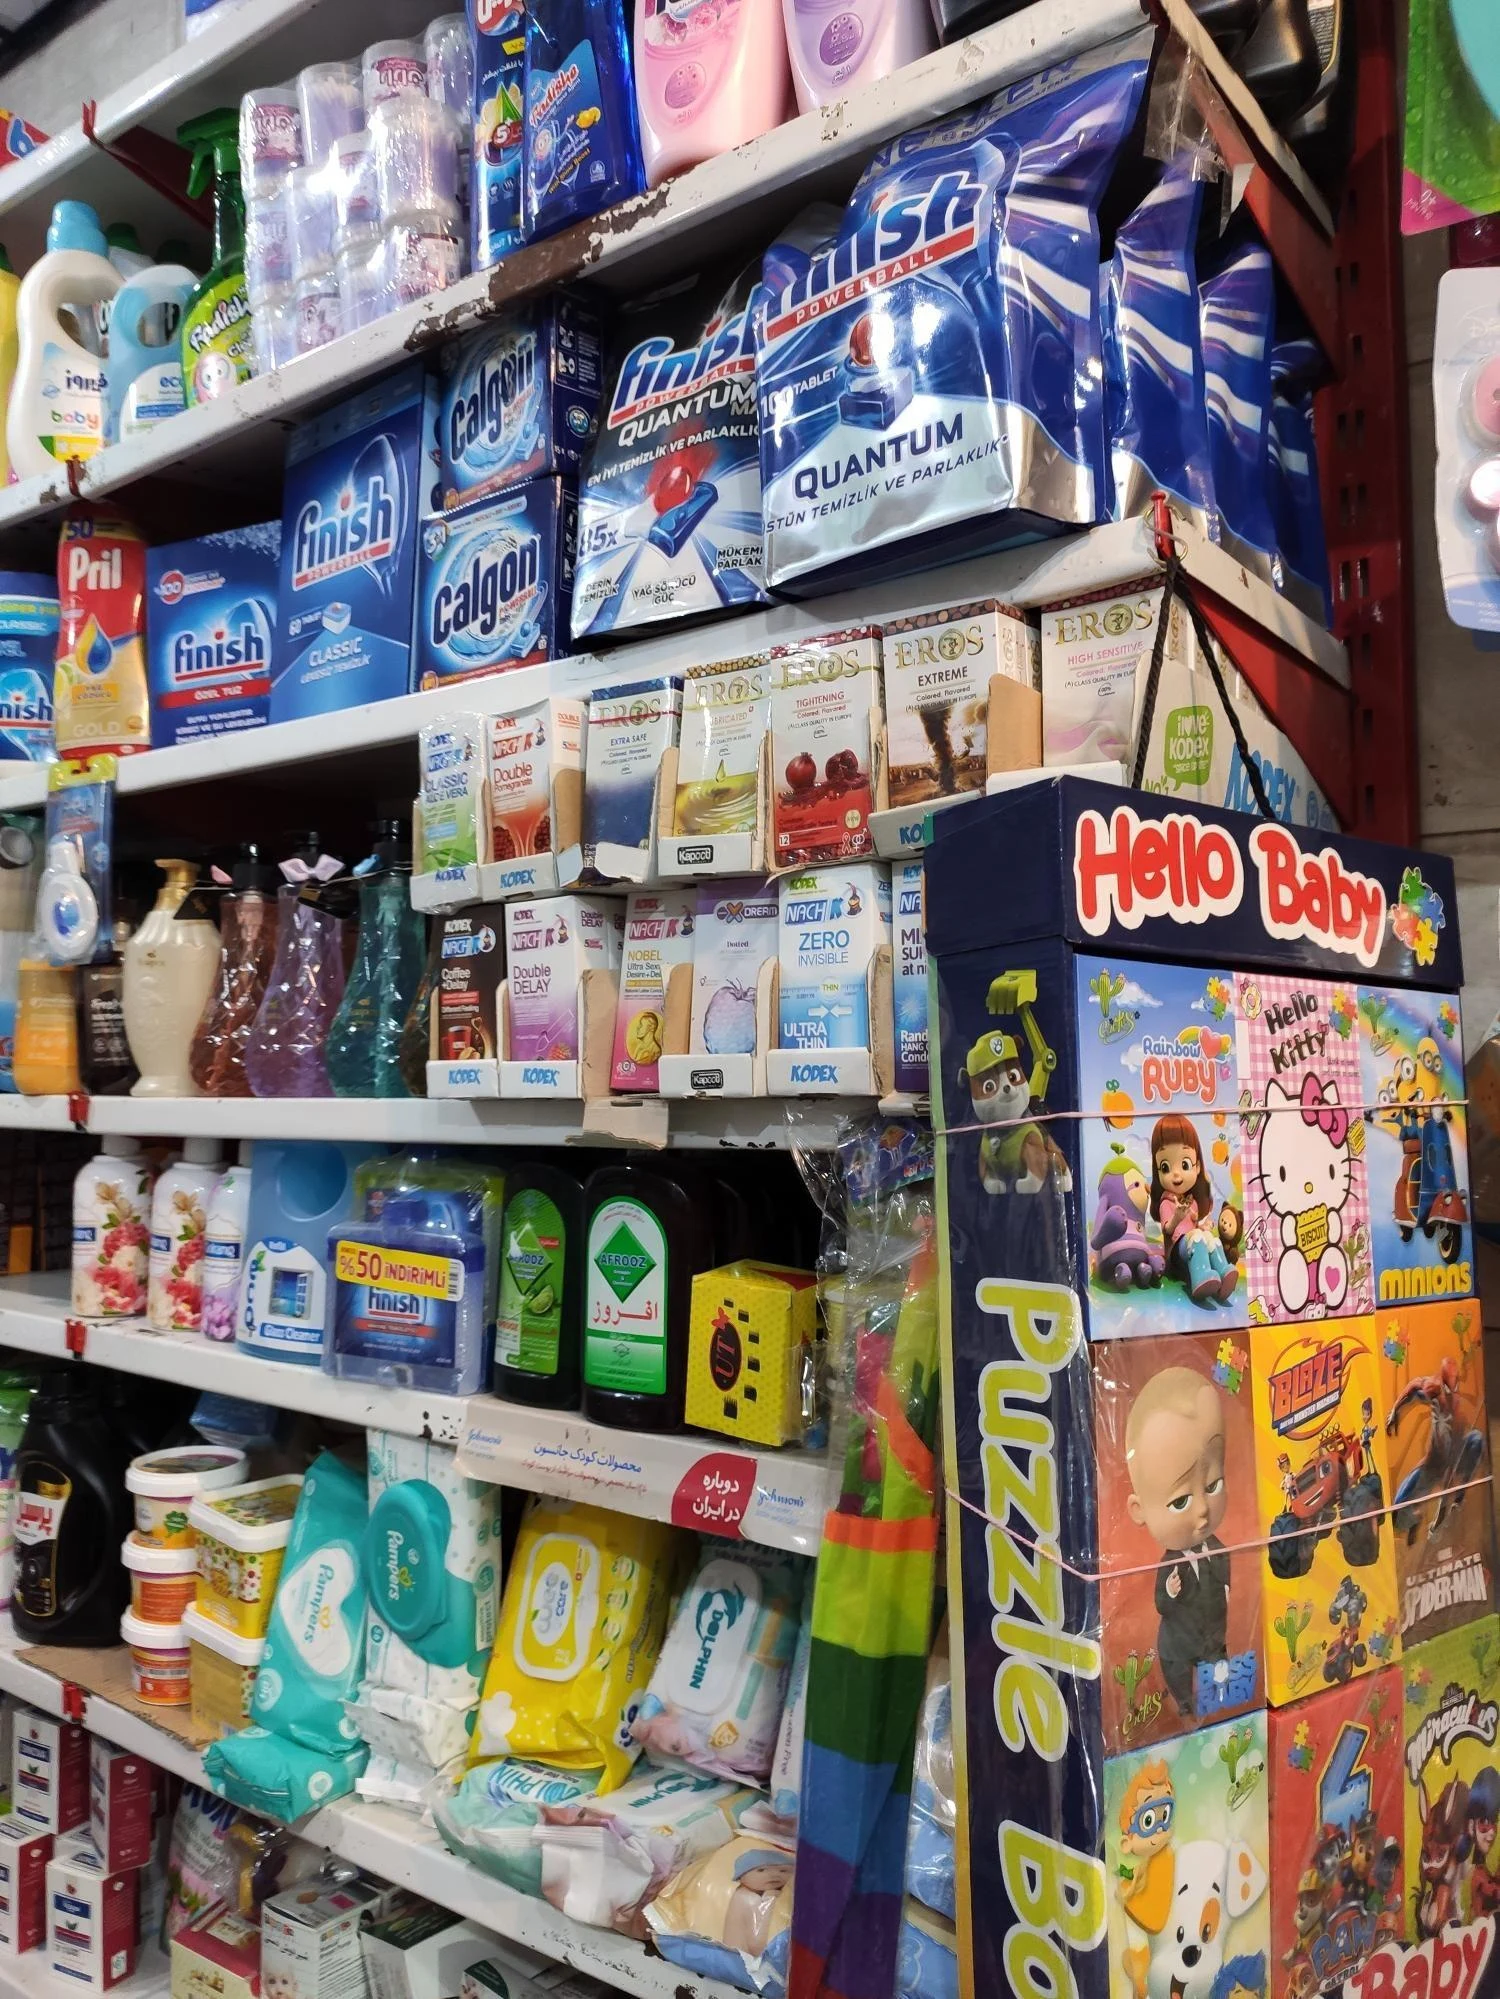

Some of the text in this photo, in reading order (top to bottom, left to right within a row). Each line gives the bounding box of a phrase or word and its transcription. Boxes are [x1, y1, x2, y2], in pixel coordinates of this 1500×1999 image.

[795, 251, 934, 324] POWERBALL
[634, 362, 744, 415] POWERBALL
[794, 365, 838, 397] TABLET
[51, 409, 99, 429] baby
[618, 383, 757, 448] QUANTUM
[669, 437, 685, 454] VE
[794, 412, 963, 500] QUANTUM
[762, 511, 805, 535] STÜN
[811, 483, 878, 521] TEMİZLİK
[884, 474, 907, 493] VE
[294, 477, 394, 580] finish
[68, 546, 123, 592] Pril
[432, 538, 539, 647] Calgon
[1055, 600, 1153, 646] EROS
[175, 624, 264, 674] finish
[308, 636, 363, 668] CLASSIC
[896, 624, 984, 669] EROS
[1068, 641, 1145, 666] HIGH SENSITIVE
[781, 650, 860, 690] EROS
[918, 666, 968, 687] EXTREME
[1074, 679, 1092, 687] CLASS
[1092, 674, 1115, 685] QUALITY
[694, 673, 763, 706] EROS
[796, 691, 845, 709] TIGHTENING
[598, 698, 662, 729] EROS
[73, 721, 121, 737] GOLD
[610, 733, 648, 747] EXTRA SAFE
[494, 762, 533, 784] Double
[779, 835, 790, 846] 12
[899, 824, 924, 845] KO
[435, 868, 467, 883] KODEX
[500, 868, 536, 889] KODEX
[789, 876, 818, 890] KODEX
[1077, 810, 1384, 960] Hello Baby
[513, 908, 536, 921] KODEX
[743, 905, 778, 917] DREAM
[785, 900, 826, 924] NACH
[629, 920, 664, 940] NACH
[798, 929, 850, 951] ZERO
[627, 950, 662, 961] NOBEL
[726, 940, 749, 948] Dotted
[513, 963, 551, 980] Double
[627, 961, 644, 971] Ultra
[798, 951, 849, 967] INVISIBLE
[902, 964, 914, 976] at
[441, 967, 471, 980] Coffee
[513, 978, 551, 995] DELAY
[822, 983, 840, 992] THIN
[1265, 989, 1319, 1035] Hello
[783, 1021, 827, 1038] ULTRA
[796, 1037, 827, 1049] THIN
[1142, 1034, 1202, 1058] Rainbow
[1269, 1028, 1328, 1076] Kitty
[449, 1068, 481, 1085] KODEX
[522, 1068, 559, 1087] KODEX
[790, 1064, 839, 1084] KODEX
[1142, 1056, 1217, 1104] RUBY
[1299, 1223, 1327, 1248] BISCUIT
[339, 1250, 382, 1282] %50
[600, 1254, 647, 1268] AFROOZ
[593, 1300, 658, 1326] افروز
[715, 1335, 738, 1382] UT
[1269, 1344, 1343, 1422] BLAZE
[533, 1442, 642, 1474] محصولات کودک جانسون
[702, 1470, 740, 1495] دوباره
[692, 1495, 726, 1521] ایران
[724, 1506, 741, 1523] در
[978, 1280, 1101, 1762] Puzzle
[387, 1529, 405, 1602] Pampers
[1406, 1552, 1482, 1586] ULTIMATE
[303, 1562, 336, 1644] Pampers
[688, 1608, 726, 1690] DOLPHIN
[1311, 1912, 1377, 1979] PAW
[1350, 1926, 1489, 1999] Baby
